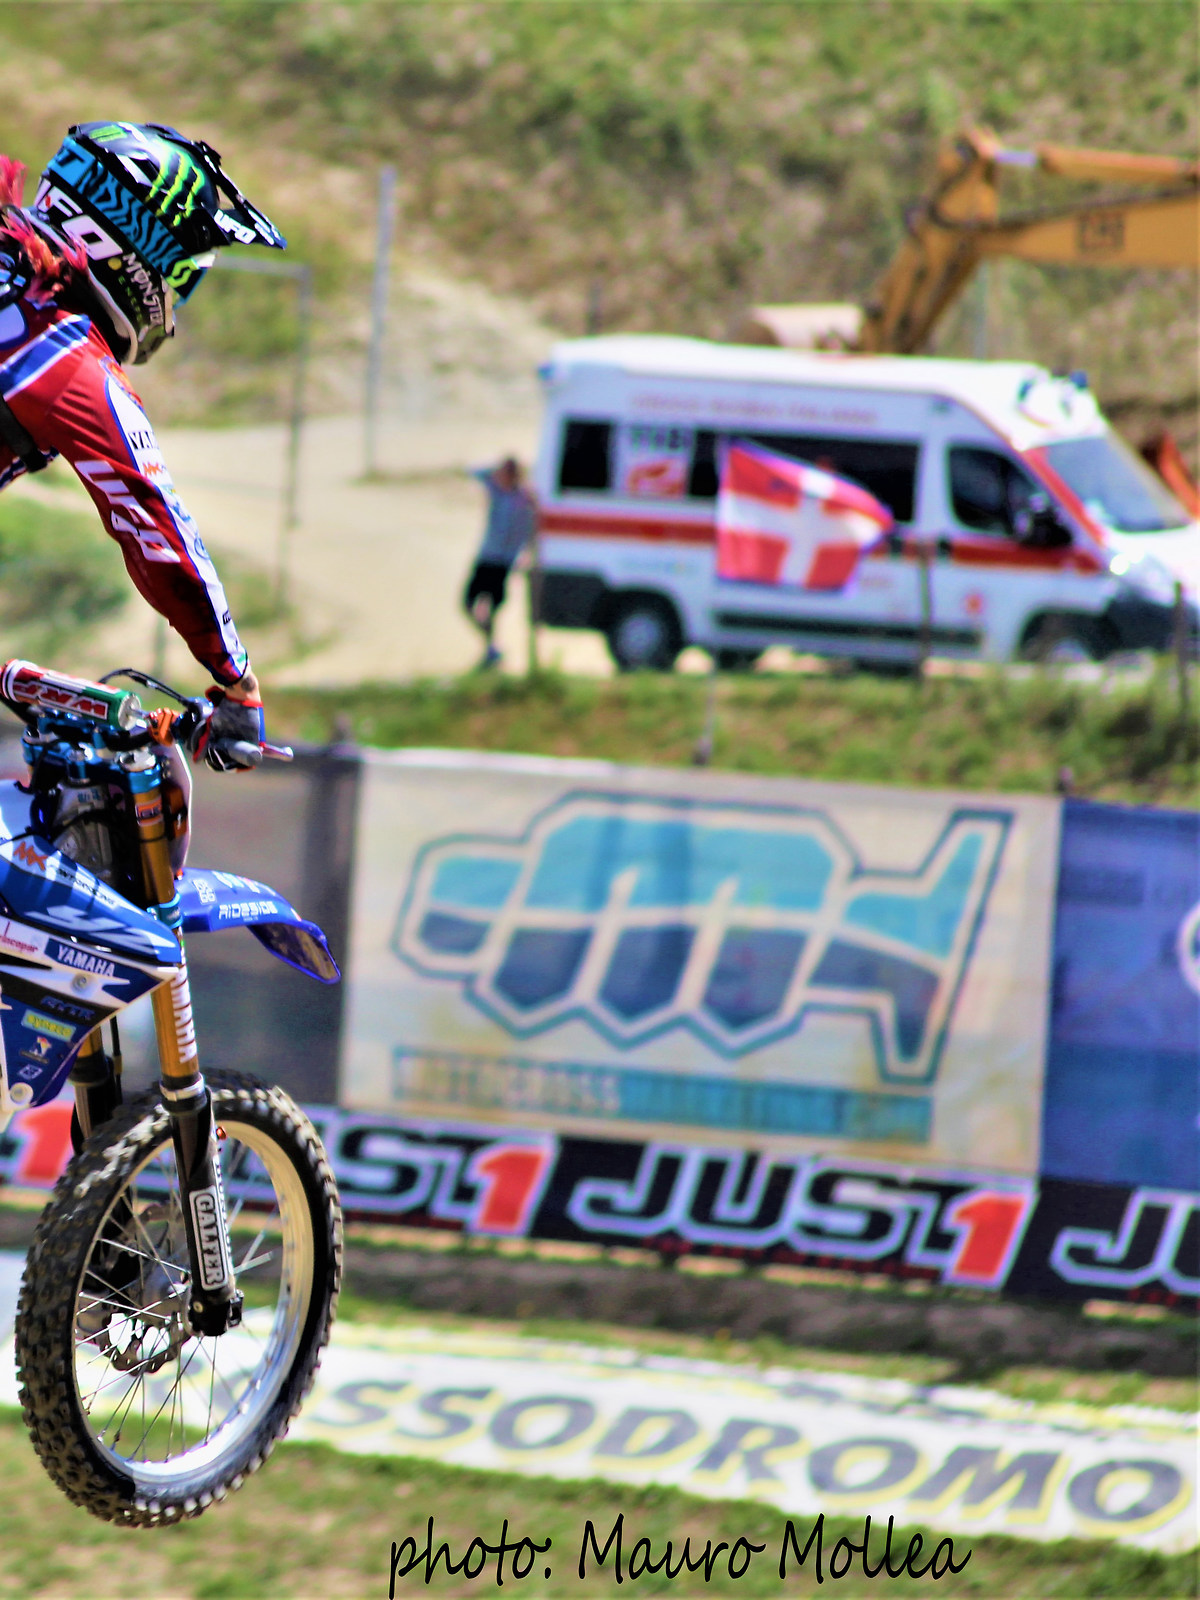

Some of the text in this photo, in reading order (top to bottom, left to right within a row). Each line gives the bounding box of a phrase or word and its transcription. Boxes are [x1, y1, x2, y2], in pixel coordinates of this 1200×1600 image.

[212, 208, 257, 245] UFO
[74, 460, 181, 563] UFO
[56, 942, 117, 978] YAMAHA
[169, 958, 198, 1065] AMAHA
[194, 1193, 225, 1286] GALFER
[568, 1141, 1038, 1290] JUST1
